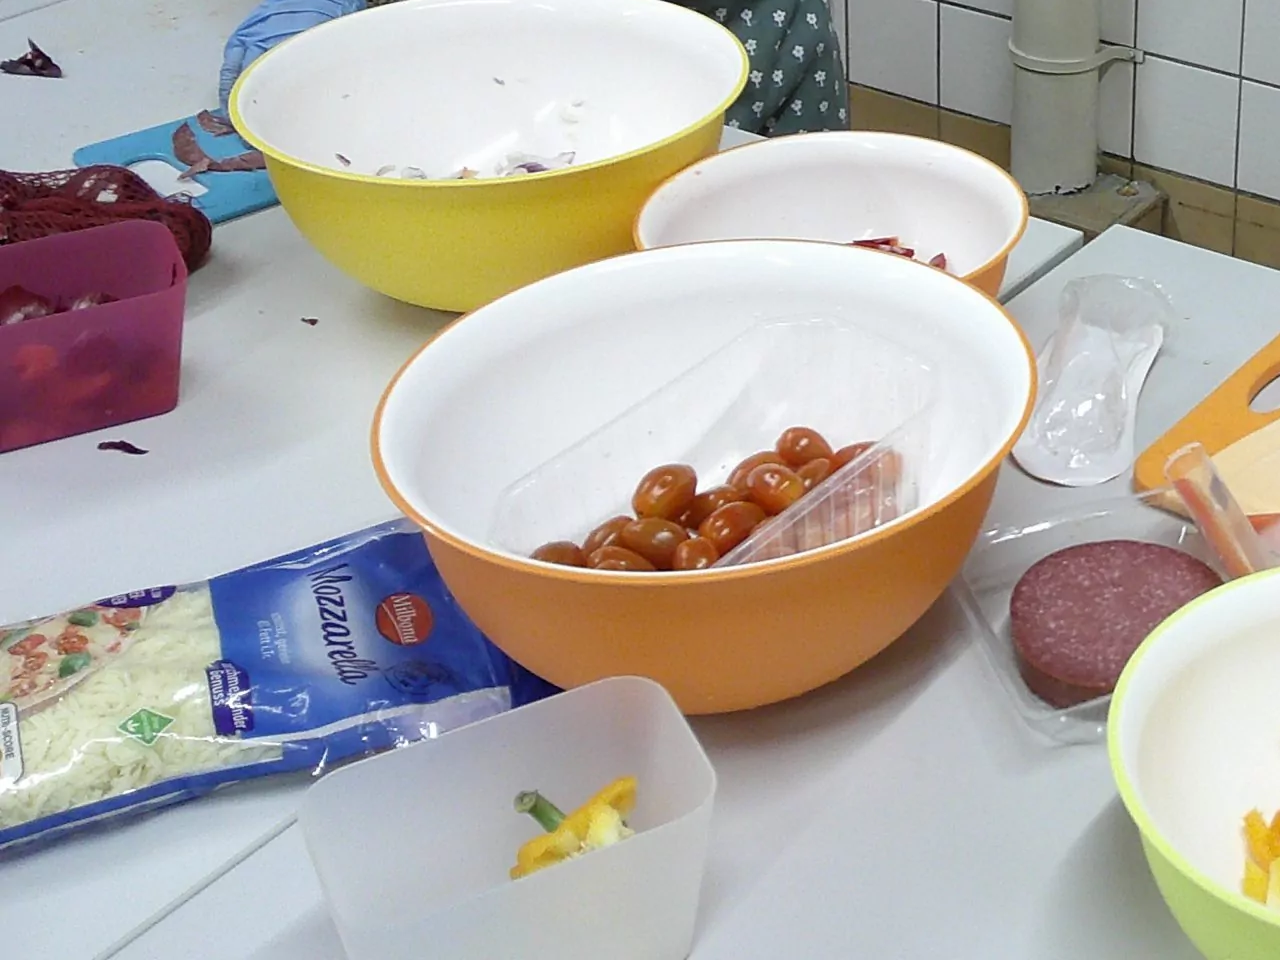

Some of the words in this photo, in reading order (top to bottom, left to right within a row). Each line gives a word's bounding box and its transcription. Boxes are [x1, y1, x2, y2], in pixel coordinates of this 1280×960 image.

[306, 562, 379, 686] Mozzarella
[390, 594, 418, 644] Milbona
[209, 668, 225, 707] Genuss
